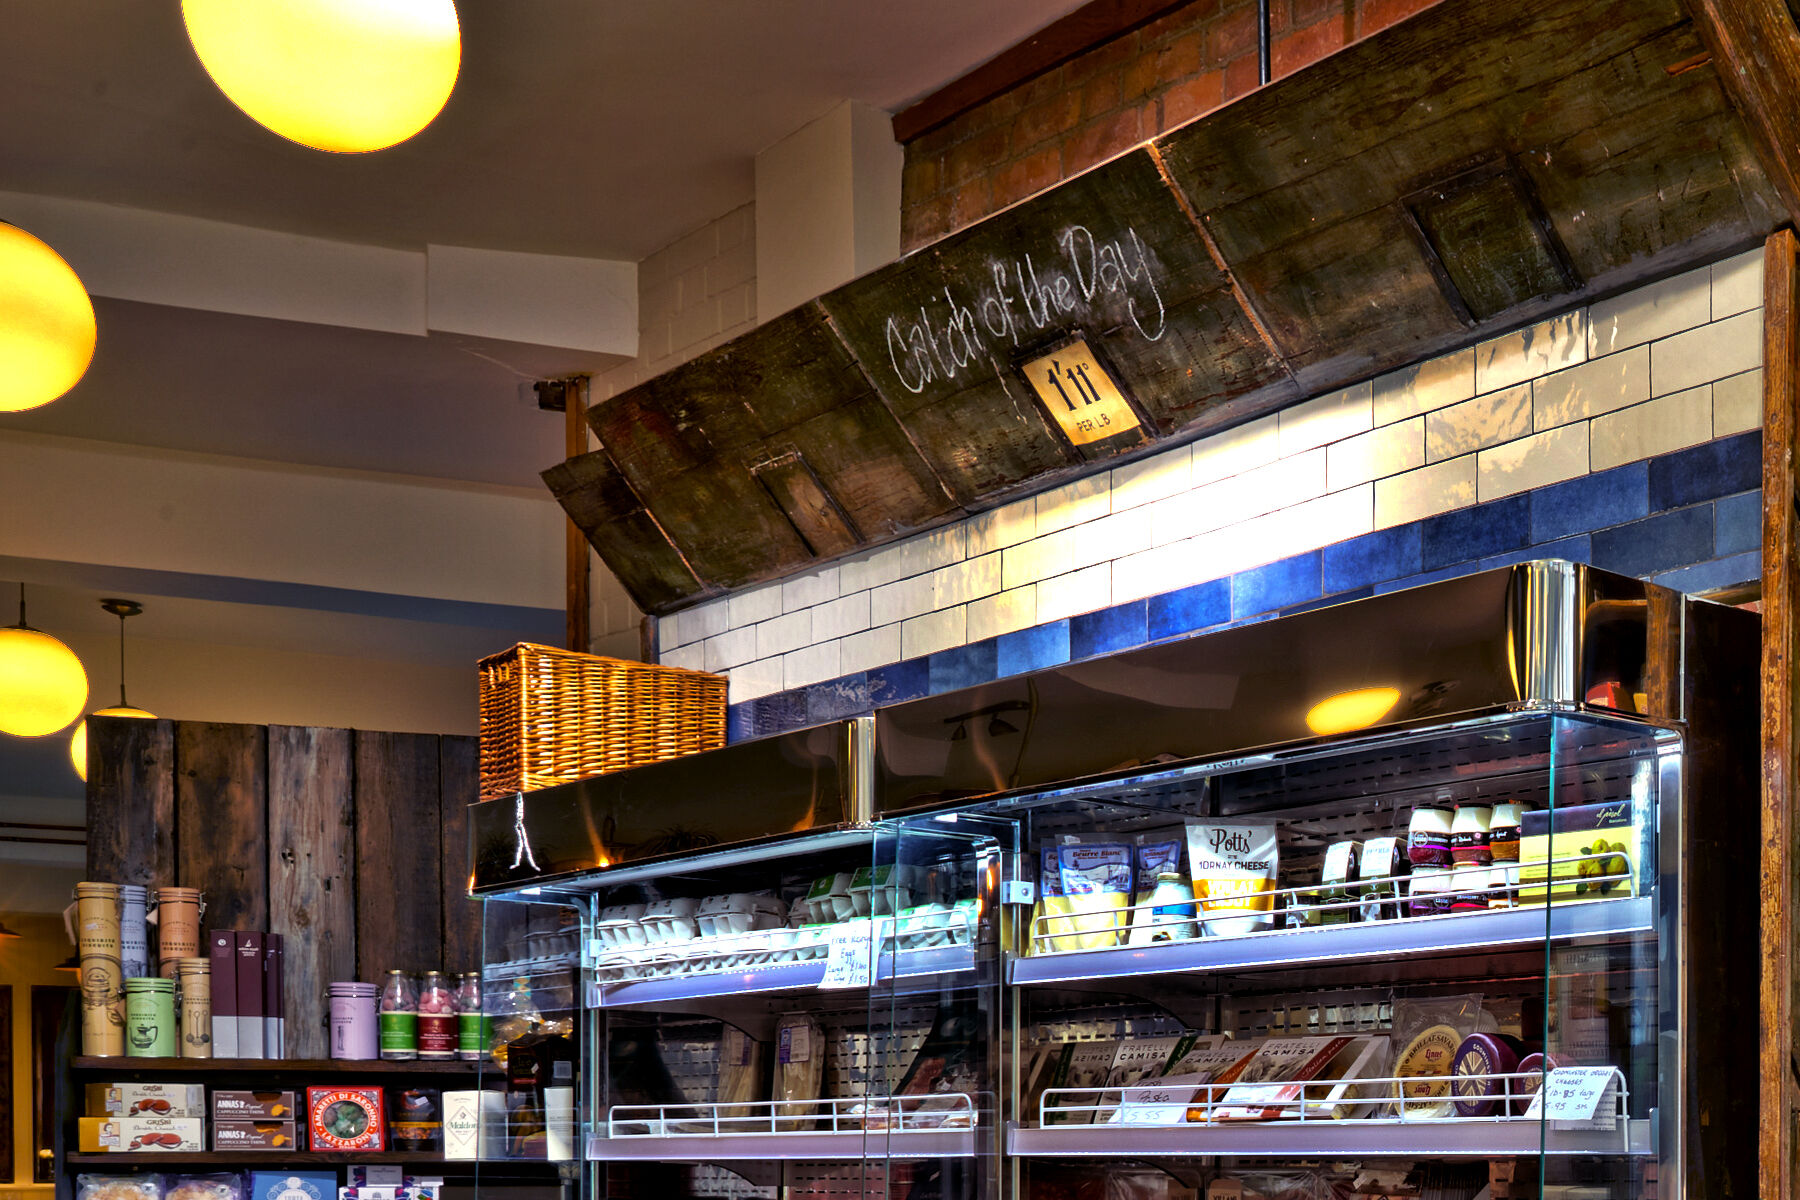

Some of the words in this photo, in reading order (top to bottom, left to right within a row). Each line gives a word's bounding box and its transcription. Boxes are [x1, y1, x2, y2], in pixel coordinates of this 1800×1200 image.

[887, 286, 984, 393] Catch
[982, 262, 1019, 346] of
[1016, 253, 1076, 329] the
[1060, 226, 1166, 342] Day
[1077, 419, 1096, 432] PER
[1094, 413, 1110, 427] LB
[1210, 828, 1252, 854] Potts'
[1235, 860, 1269, 870] CHEESE
[1268, 1042, 1320, 1050] FRATELLI
[1119, 1051, 1168, 1060] CAMISA
[1262, 1048, 1315, 1057] CAMISA
[217, 1100, 240, 1109] ANNAS
[316, 1094, 337, 1127] AMARETTI
[351, 1094, 377, 1128] SARONNO
[218, 1131, 240, 1139] ANNAS
[321, 1131, 371, 1146] LAZZARONI
